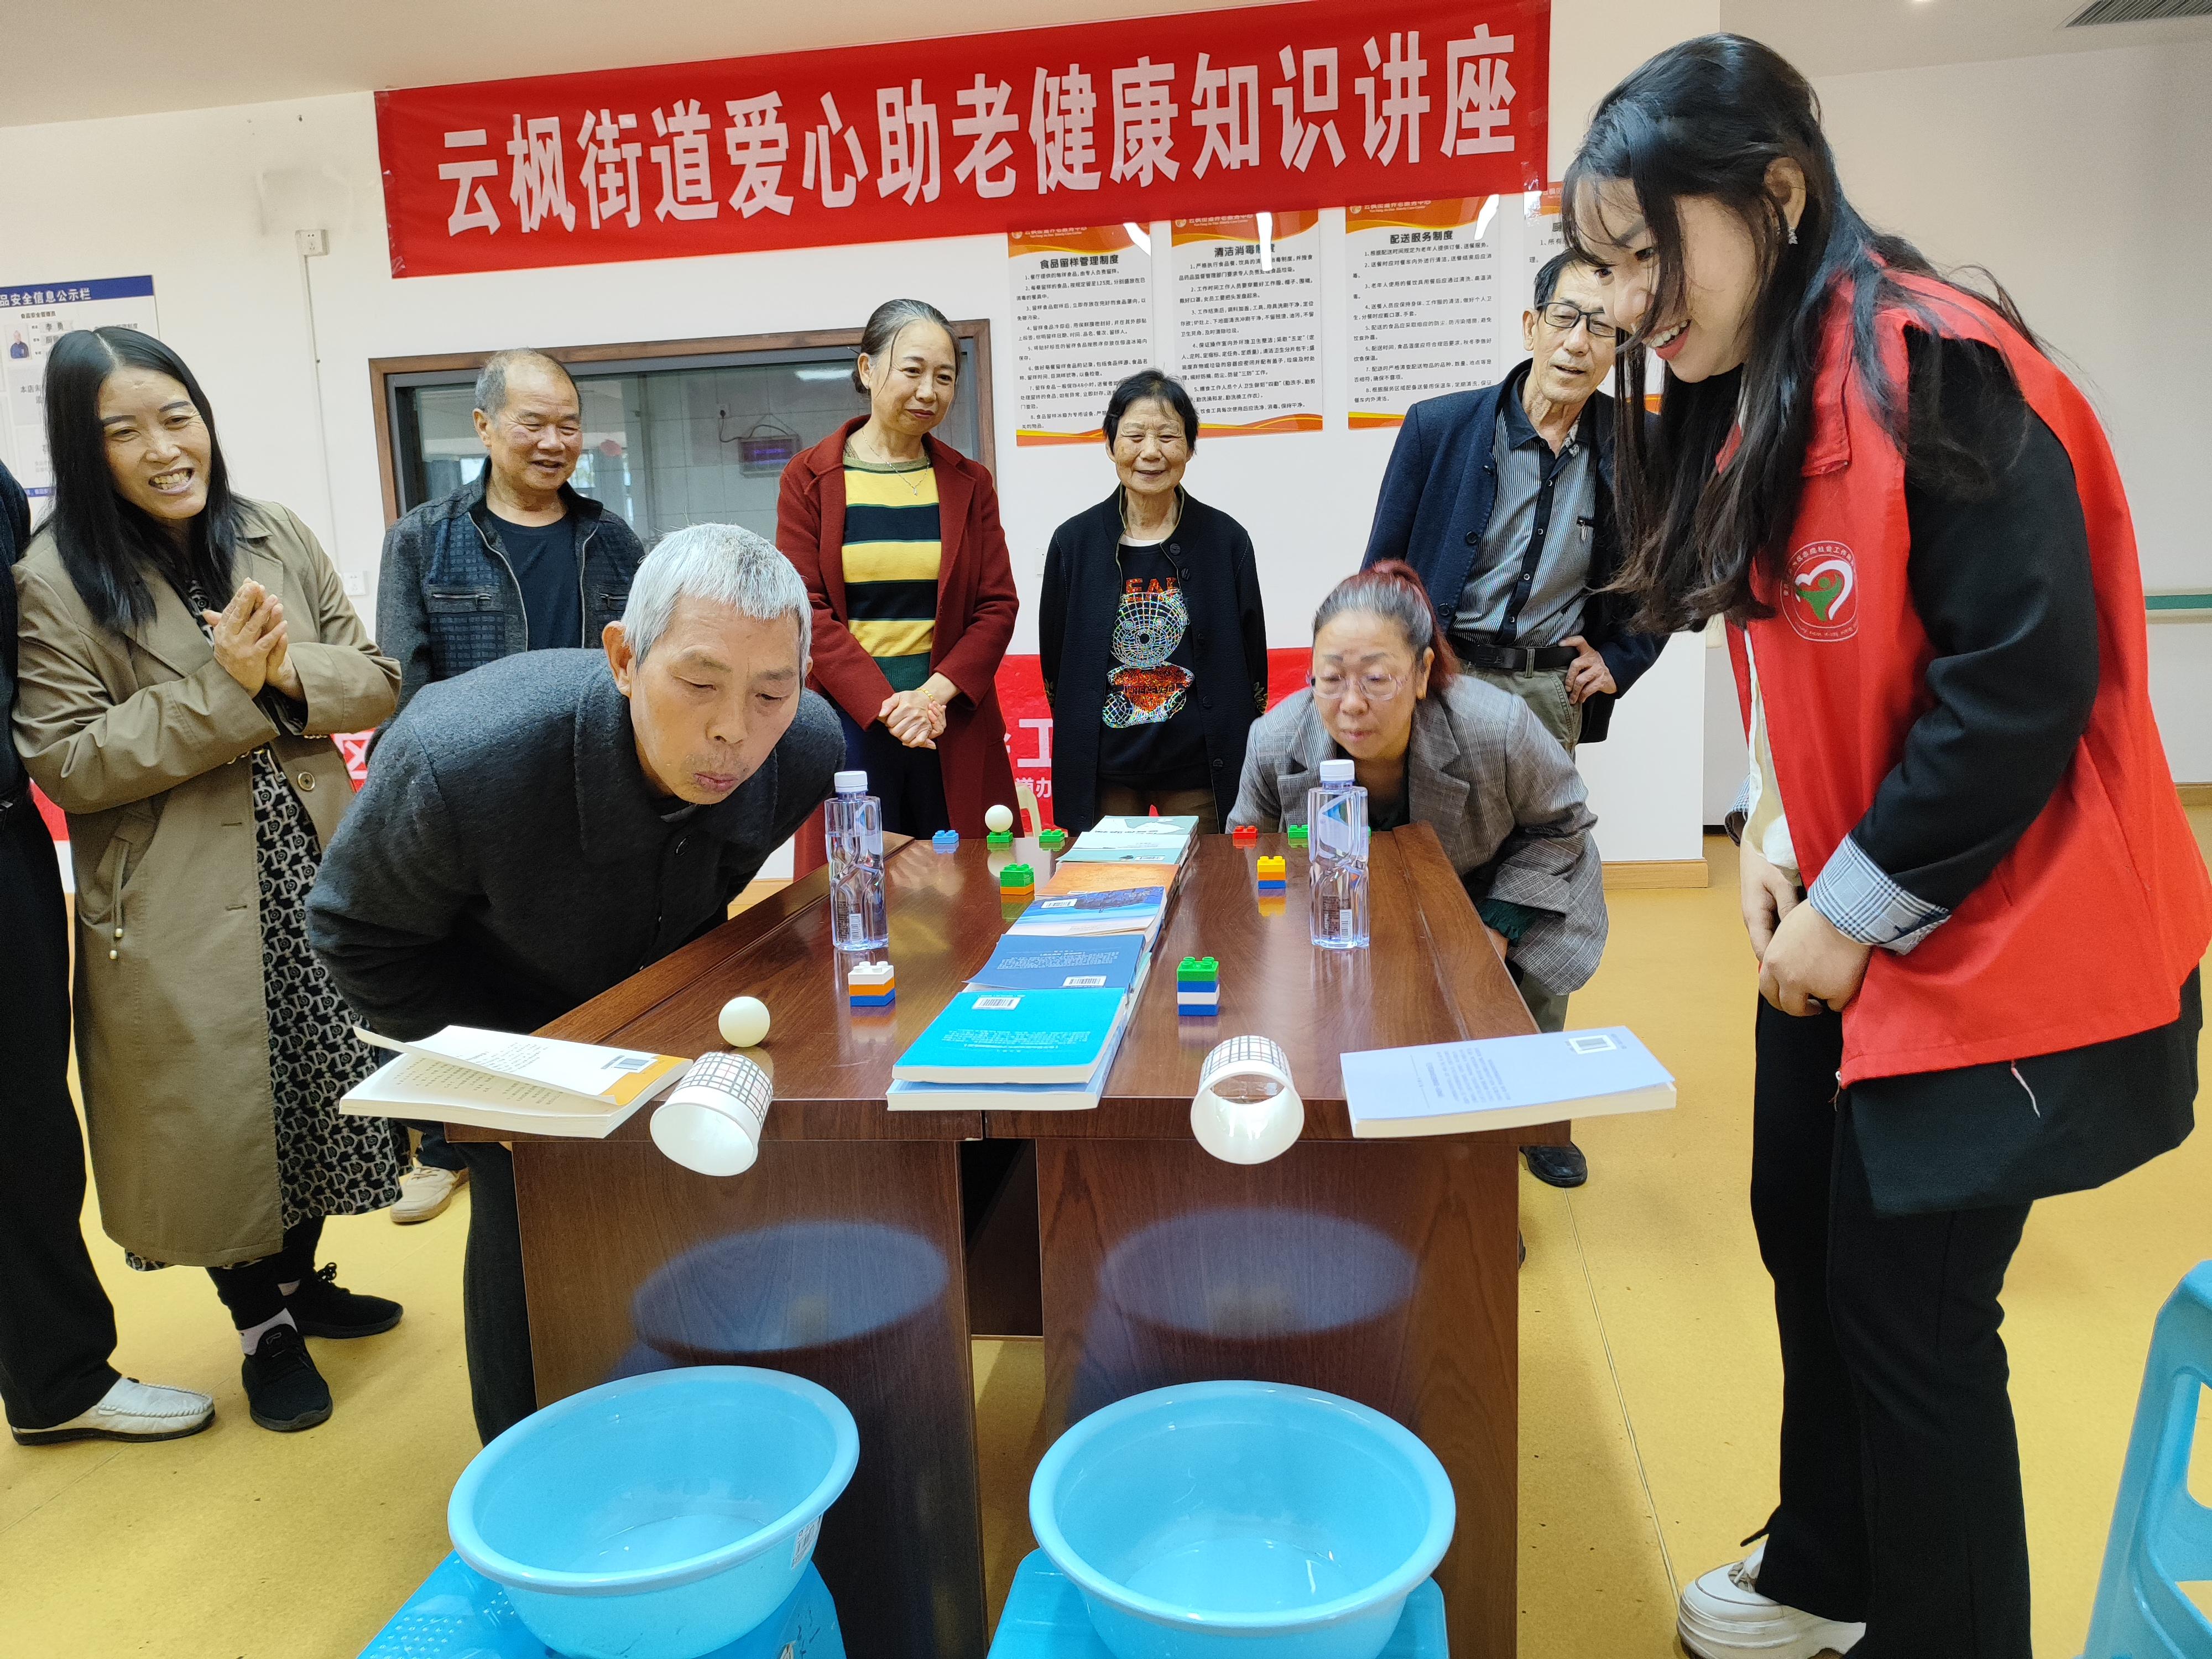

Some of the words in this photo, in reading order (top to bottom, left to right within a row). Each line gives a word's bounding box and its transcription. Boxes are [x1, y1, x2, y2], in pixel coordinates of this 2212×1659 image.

[439, 23, 1517, 237] 云枫街道爱心助老健康知识讲座
[1390, 231, 1453, 244] 配送服务制度
[1040, 254, 1119, 269] 食品留样管理制度
[0, 287, 91, 307] 品安全信息公示栏
